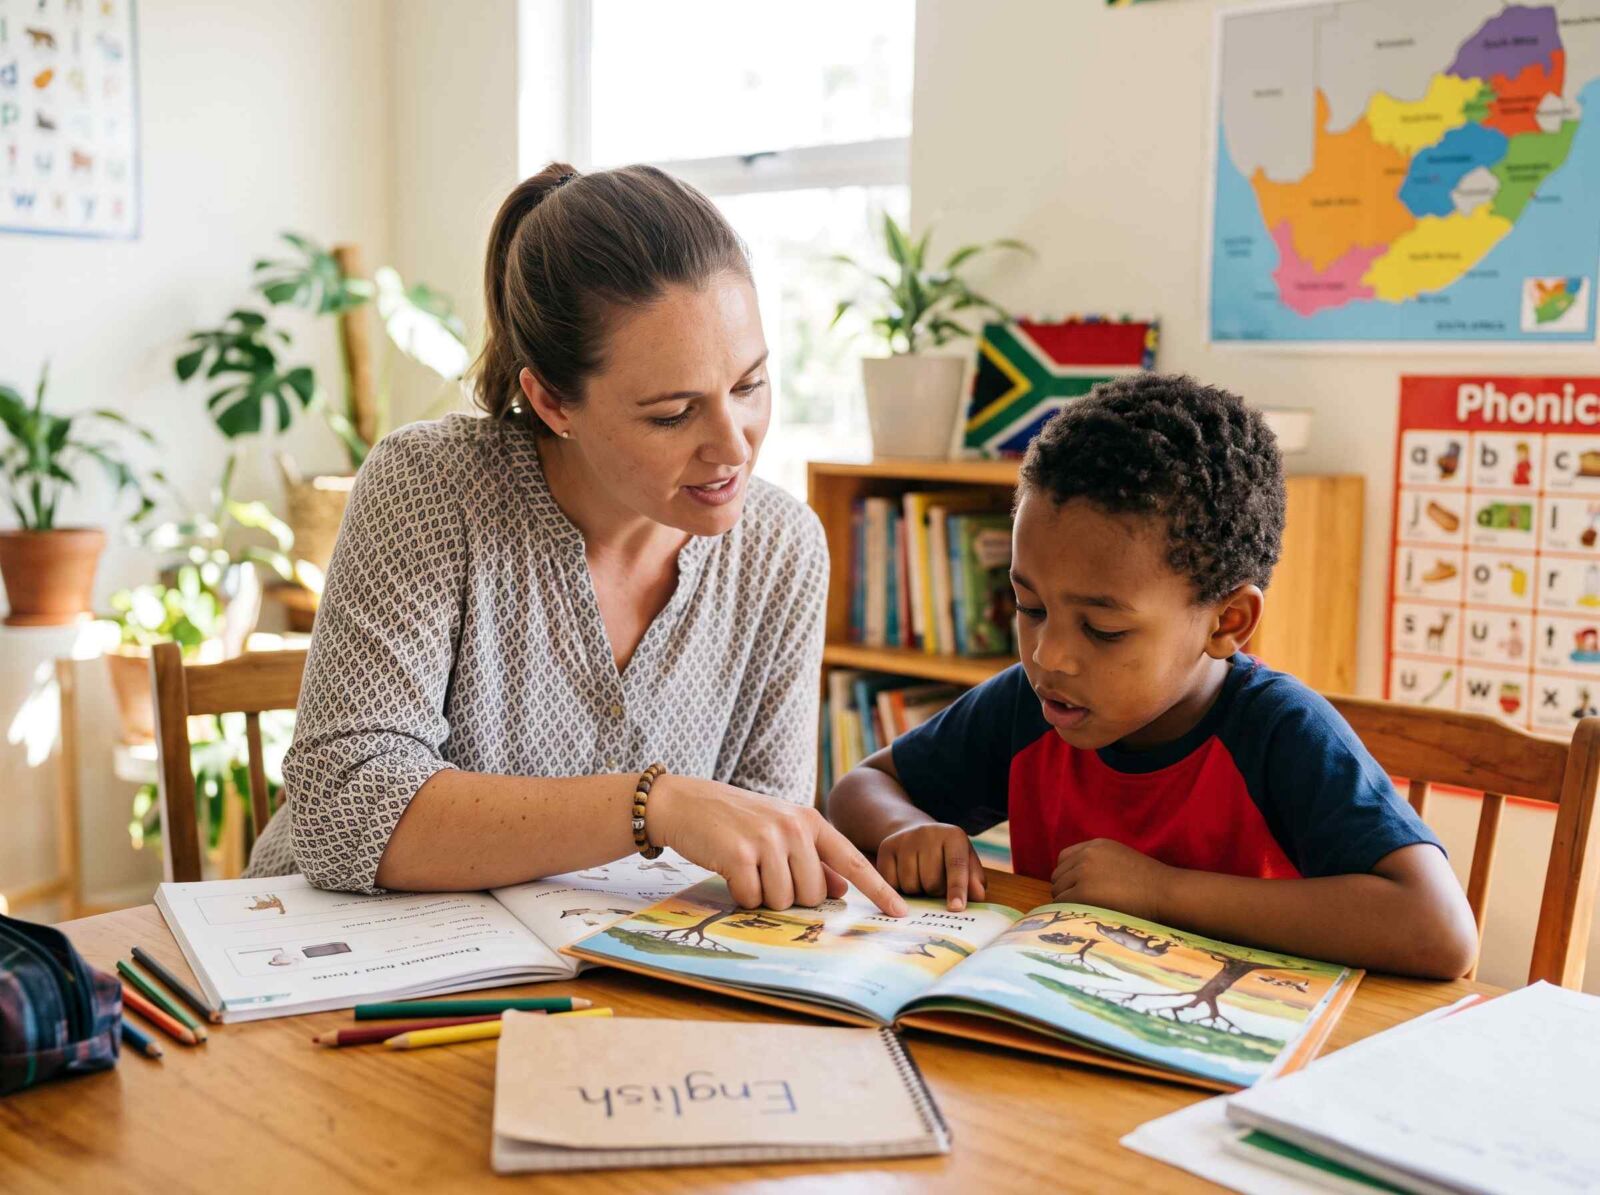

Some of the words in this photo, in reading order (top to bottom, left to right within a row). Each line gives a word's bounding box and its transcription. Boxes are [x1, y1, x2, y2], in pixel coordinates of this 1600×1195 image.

[1456, 382, 1600, 425] Phonic
[1411, 446, 1427, 465] a
[1480, 442, 1498, 467] b
[1554, 451, 1571, 470] c
[1473, 564, 1490, 585] o
[1548, 570, 1560, 588] r
[1404, 614, 1415, 633] s
[1471, 622, 1488, 641] u
[1546, 624, 1556, 647] t
[1467, 680, 1491, 698] w
[1543, 689, 1559, 708] x
[567, 1070, 797, 1118] English
